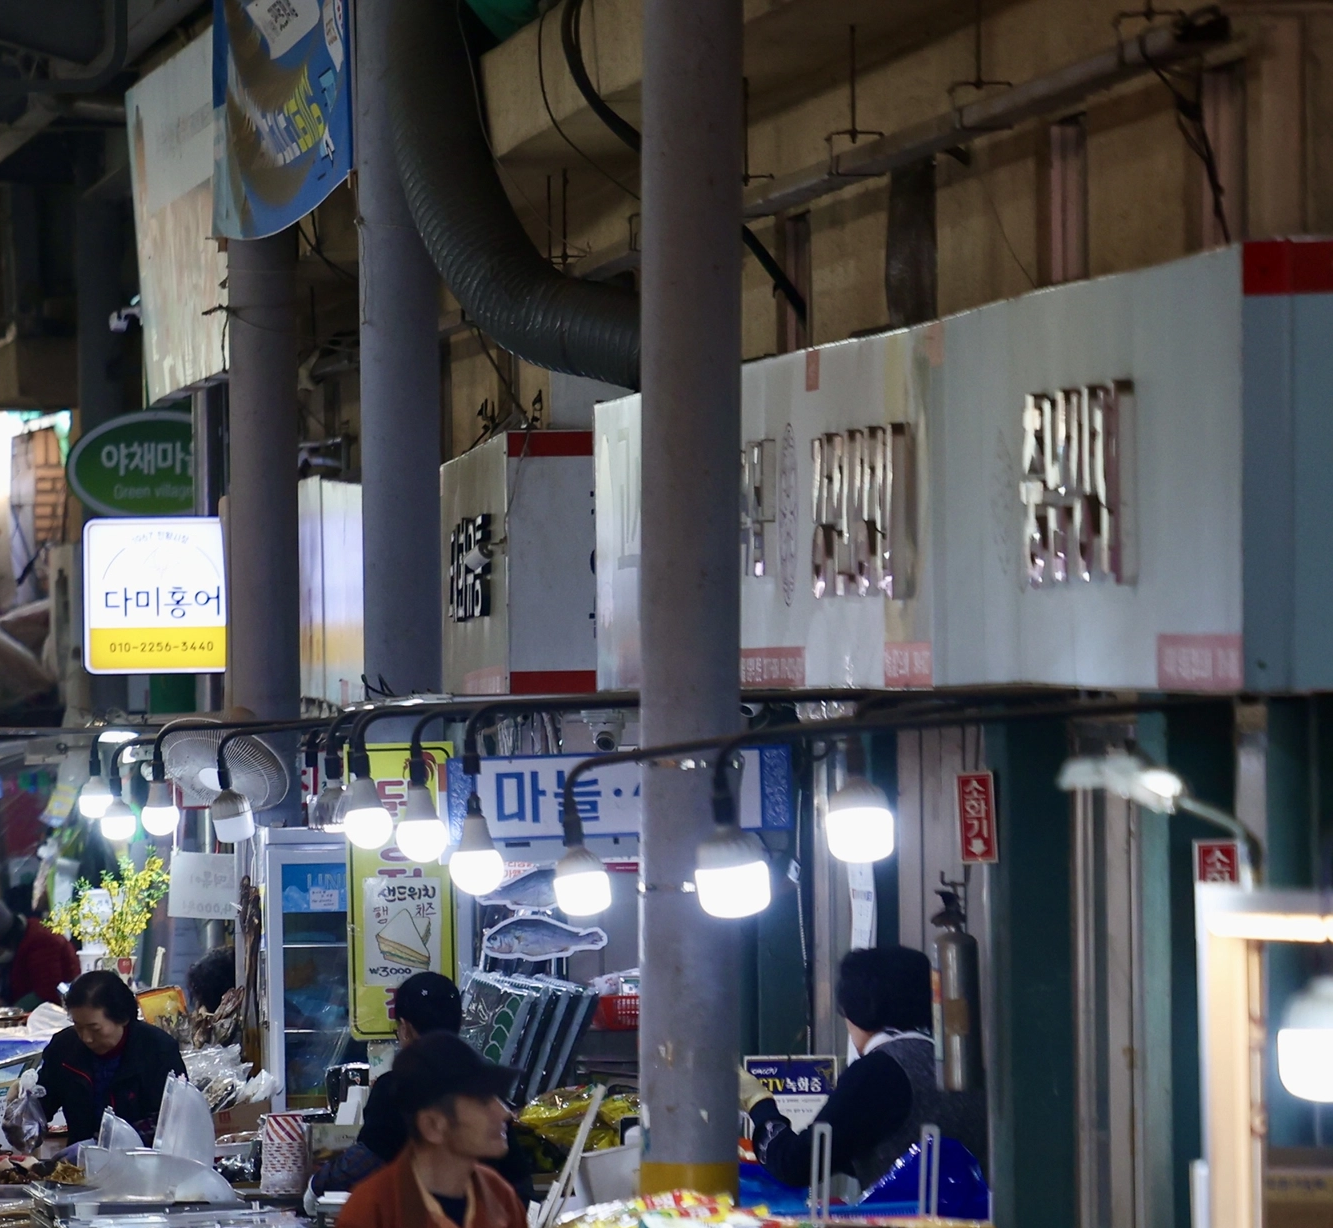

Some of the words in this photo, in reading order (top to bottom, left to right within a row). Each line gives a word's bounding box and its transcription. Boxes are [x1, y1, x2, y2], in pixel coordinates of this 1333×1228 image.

[114, 484, 150, 499] Green
[104, 586, 221, 619] 다미홍어
[109, 641, 215, 654] 010-2256-3440
[963, 778, 990, 839] 소화기
[378, 885, 437, 904] 샌드위치
[372, 905, 389, 925] 햄
[415, 902, 437, 918] 치즈
[760, 1077, 823, 1093] CTV녹화중
